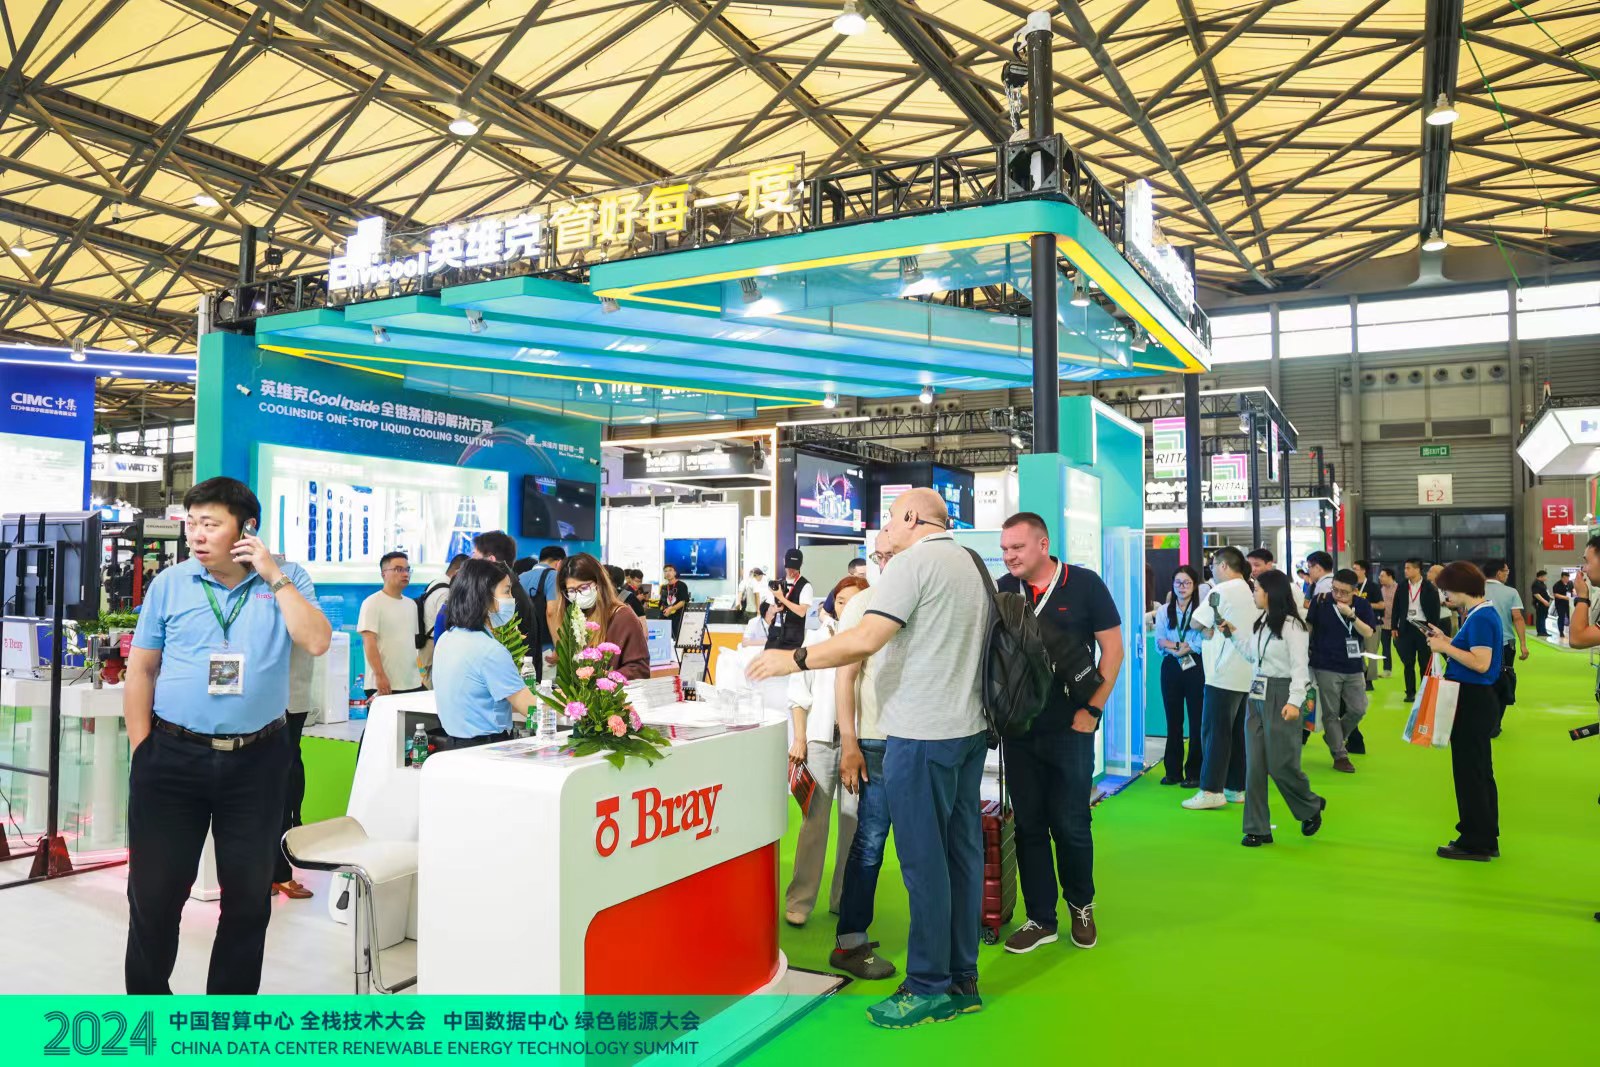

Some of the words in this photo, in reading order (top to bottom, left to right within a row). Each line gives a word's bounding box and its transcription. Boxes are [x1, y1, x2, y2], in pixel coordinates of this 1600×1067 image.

[429, 212, 543, 271] 英维克
[550, 163, 800, 254] 管好每一度
[11, 392, 53, 407] CIMC
[55, 397, 77, 411] 中集
[259, 402, 324, 421] COOLINSIDE
[326, 413, 378, 429] ONE-STOP
[380, 423, 411, 435] LIQUID
[413, 428, 452, 442] COOLING
[454, 434, 493, 448] SOLUTION
[128, 462, 158, 472] WATTS
[1214, 482, 1245, 490] RITTAL
[1426, 489, 1444, 502] E2
[1547, 504, 1568, 518] E3
[630, 784, 723, 848] Bray
